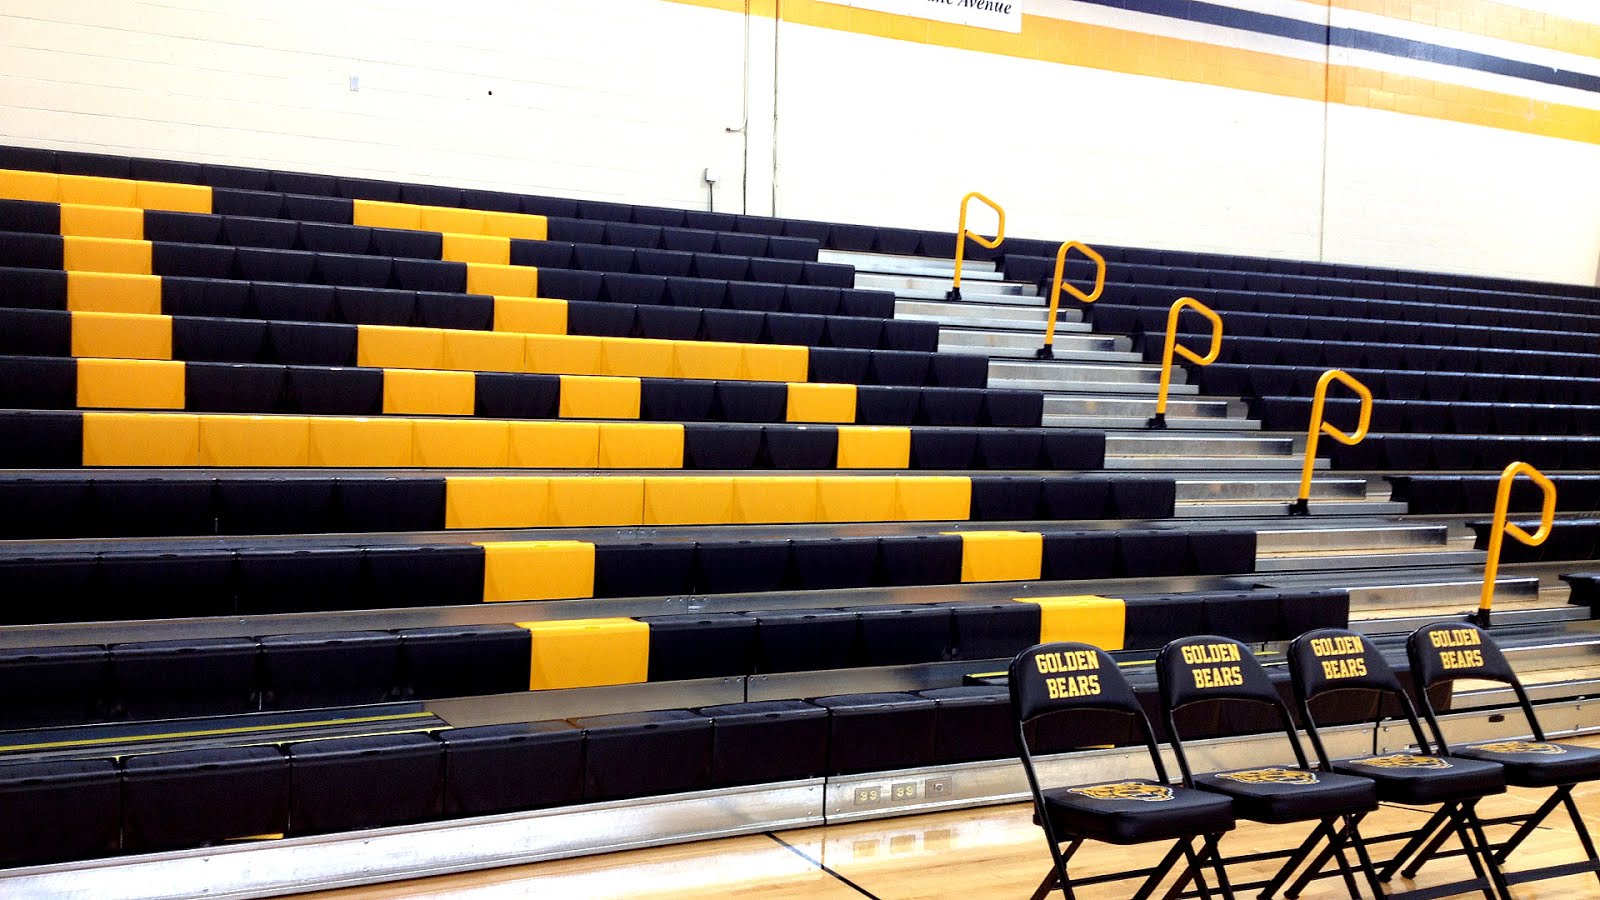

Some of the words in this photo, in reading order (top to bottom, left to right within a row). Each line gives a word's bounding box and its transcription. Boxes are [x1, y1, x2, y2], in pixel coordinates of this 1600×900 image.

[1310, 635, 1365, 656] GOLDEN
[1428, 628, 1481, 648] GOLDEN
[1035, 650, 1099, 674] GOLDEN
[1181, 643, 1241, 664] GOLDEN
[1439, 649, 1485, 669] BEARS
[1191, 665, 1243, 688] BEARS
[1321, 657, 1367, 679] BEARS
[1046, 675, 1101, 699] BEARS
